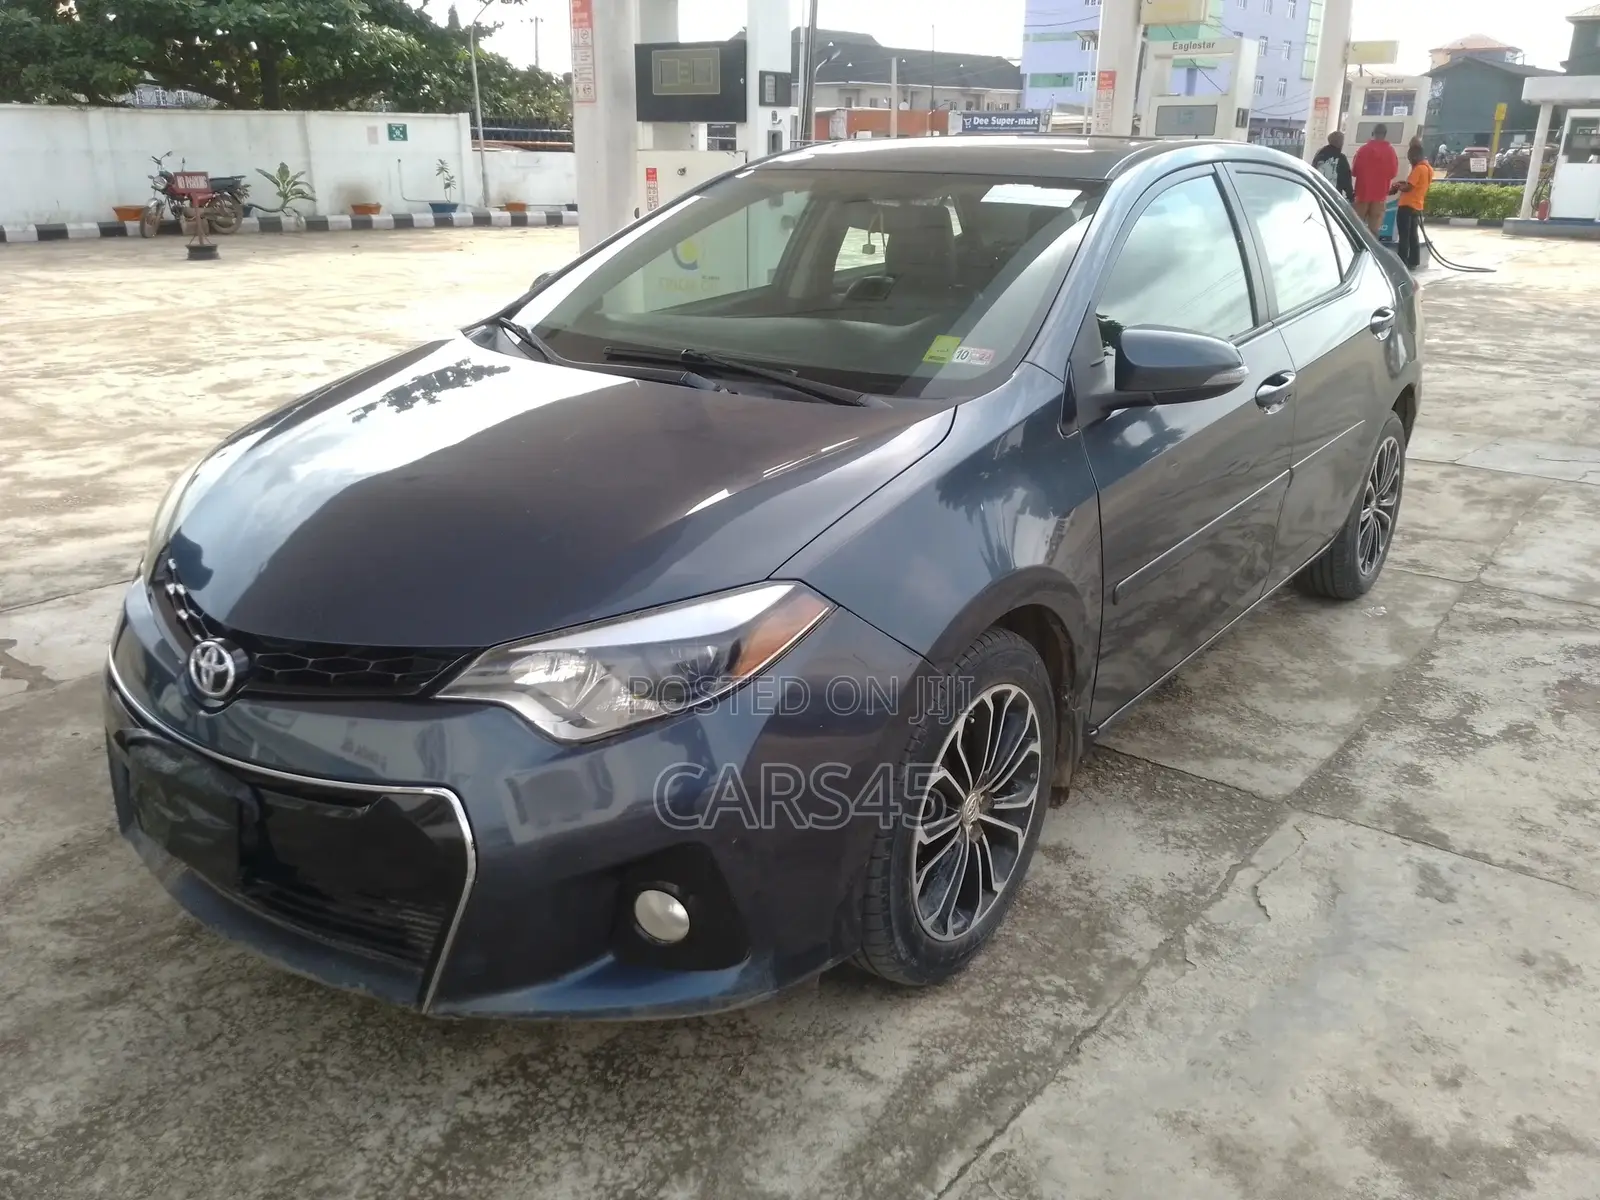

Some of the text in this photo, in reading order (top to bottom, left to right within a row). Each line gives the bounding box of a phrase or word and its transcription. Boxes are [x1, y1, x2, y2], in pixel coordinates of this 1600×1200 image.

[1172, 41, 1216, 52] Eaglestar
[1371, 77, 1405, 86] Eaglestar
[973, 116, 1038, 127] Dee Super-mart
[176, 175, 208, 189] NO PARKING
[956, 349, 970, 361] 10
